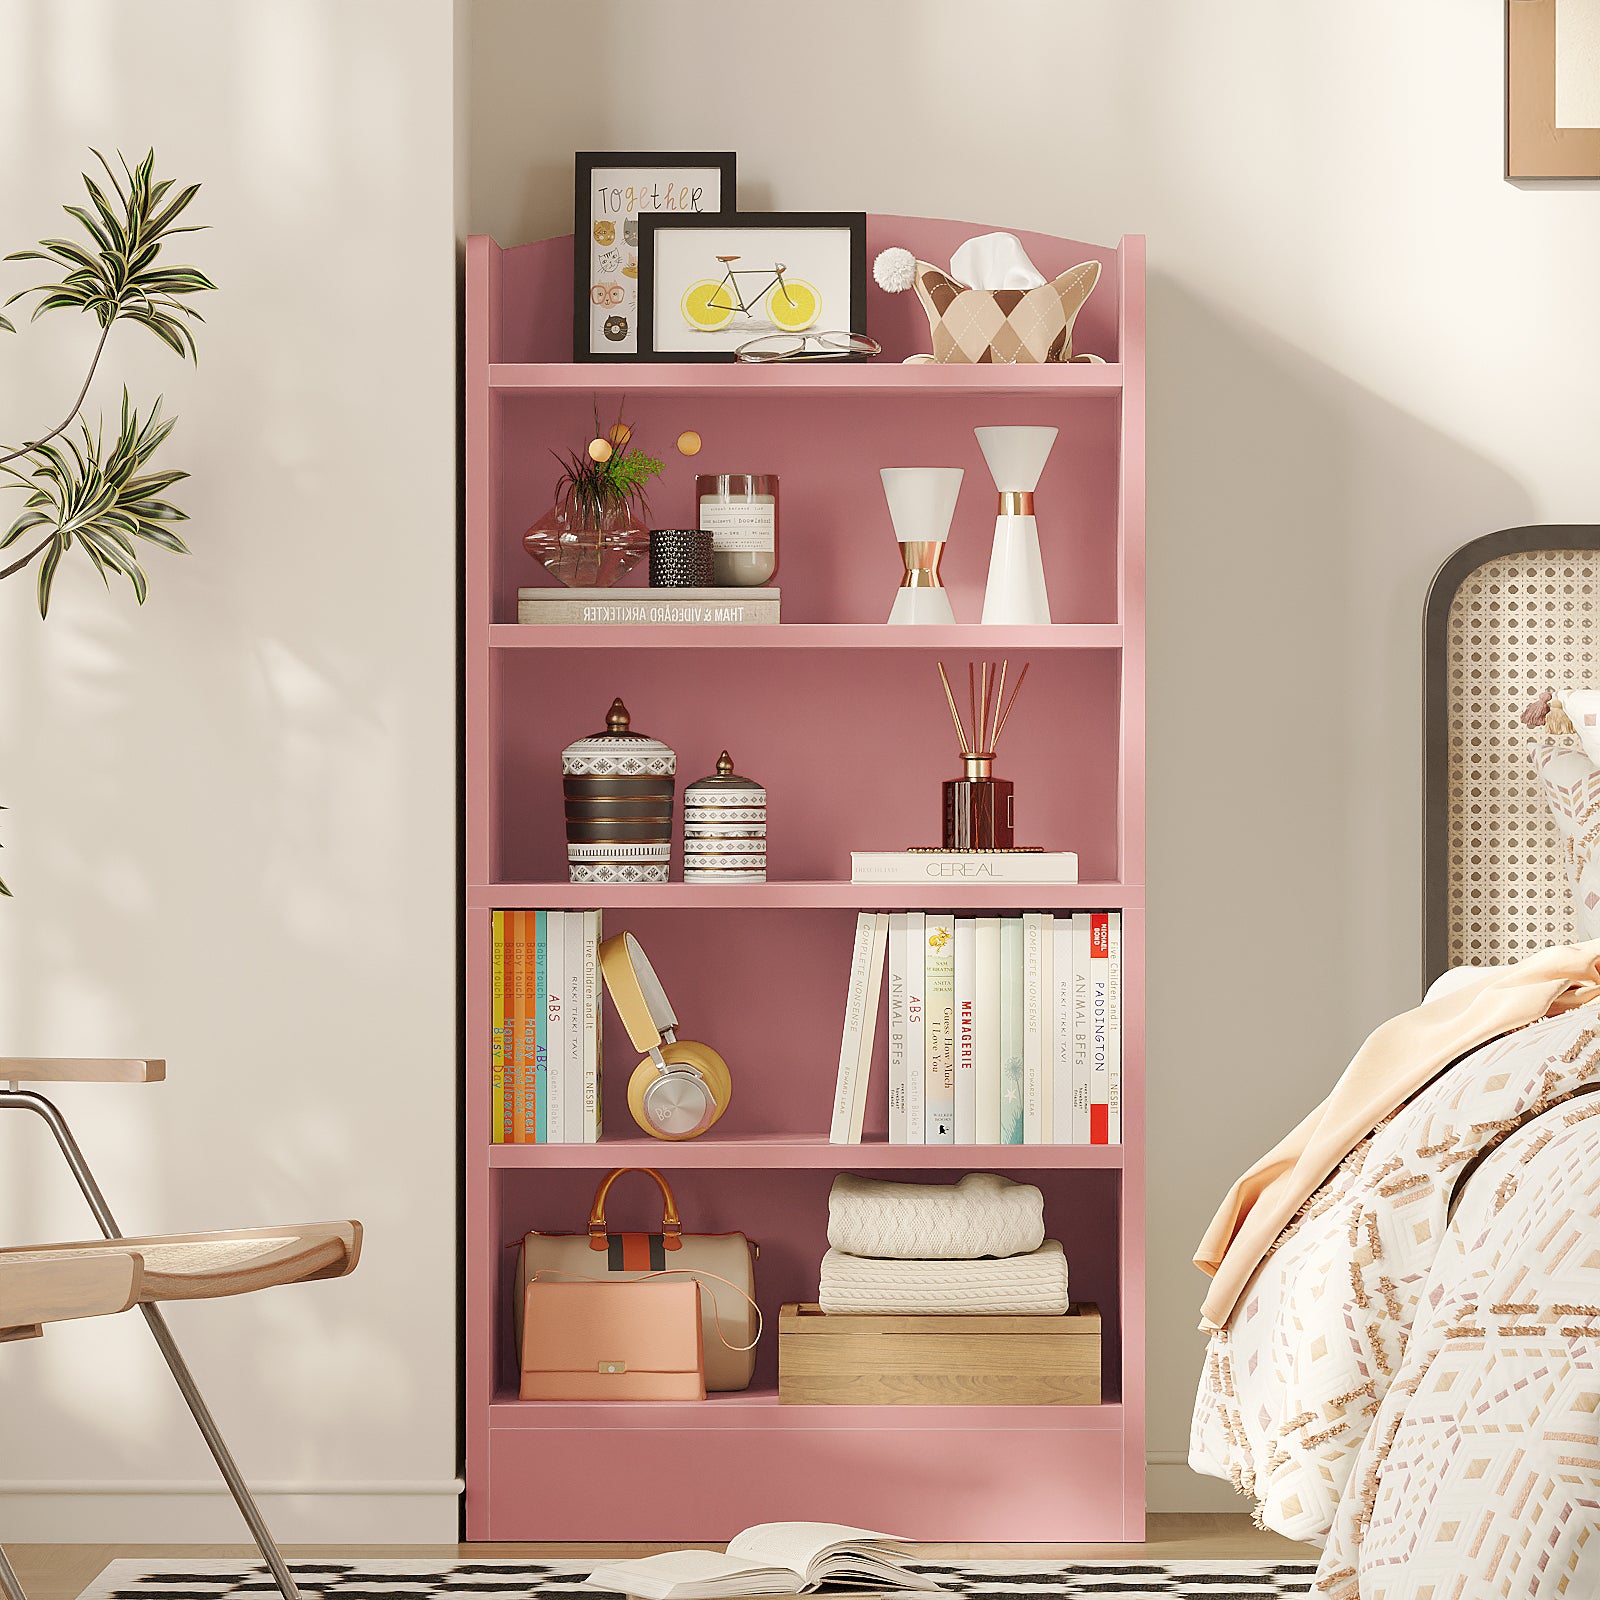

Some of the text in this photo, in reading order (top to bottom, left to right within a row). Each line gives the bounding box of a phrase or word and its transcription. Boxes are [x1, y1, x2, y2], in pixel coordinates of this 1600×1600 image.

[926, 863, 1003, 876] CEREAL
[493, 942, 503, 999] Baby touch
[504, 942, 514, 999] Baby touch
[515, 942, 524, 999] Baby touch
[526, 942, 535, 999] Baby touch
[536, 942, 545, 999] Baby touch
[586, 940, 594, 1029] Five Children and It
[850, 924, 871, 1032] COMPLETE NONSENSE
[1029, 925, 1037, 1033] COMPLETE NONSENSE
[1110, 941, 1118, 1031] Five Children and It
[549, 994, 560, 1022] ABS
[910, 995, 921, 1023] ABS
[961, 1001, 971, 1069] MENAGERIE
[1094, 982, 1104, 1072] PADDINGTON
[493, 1027, 504, 1088] Busy Day
[537, 1045, 546, 1071] ABC
[892, 1033, 903, 1065] BFFs
[932, 1029, 940, 1052] Love
[932, 1055, 941, 1073] You
[943, 1007, 952, 1089] Guess How Much
[1075, 1033, 1086, 1065] BFFs
[504, 1018, 514, 1134] Happy Halloween
[525, 1018, 536, 1134] Happy Halloween
[586, 1071, 594, 1114] E. NESBIT
[839, 1066, 850, 1115] EDWARD LEAR
[1110, 1072, 1118, 1115] E. NESBIT
